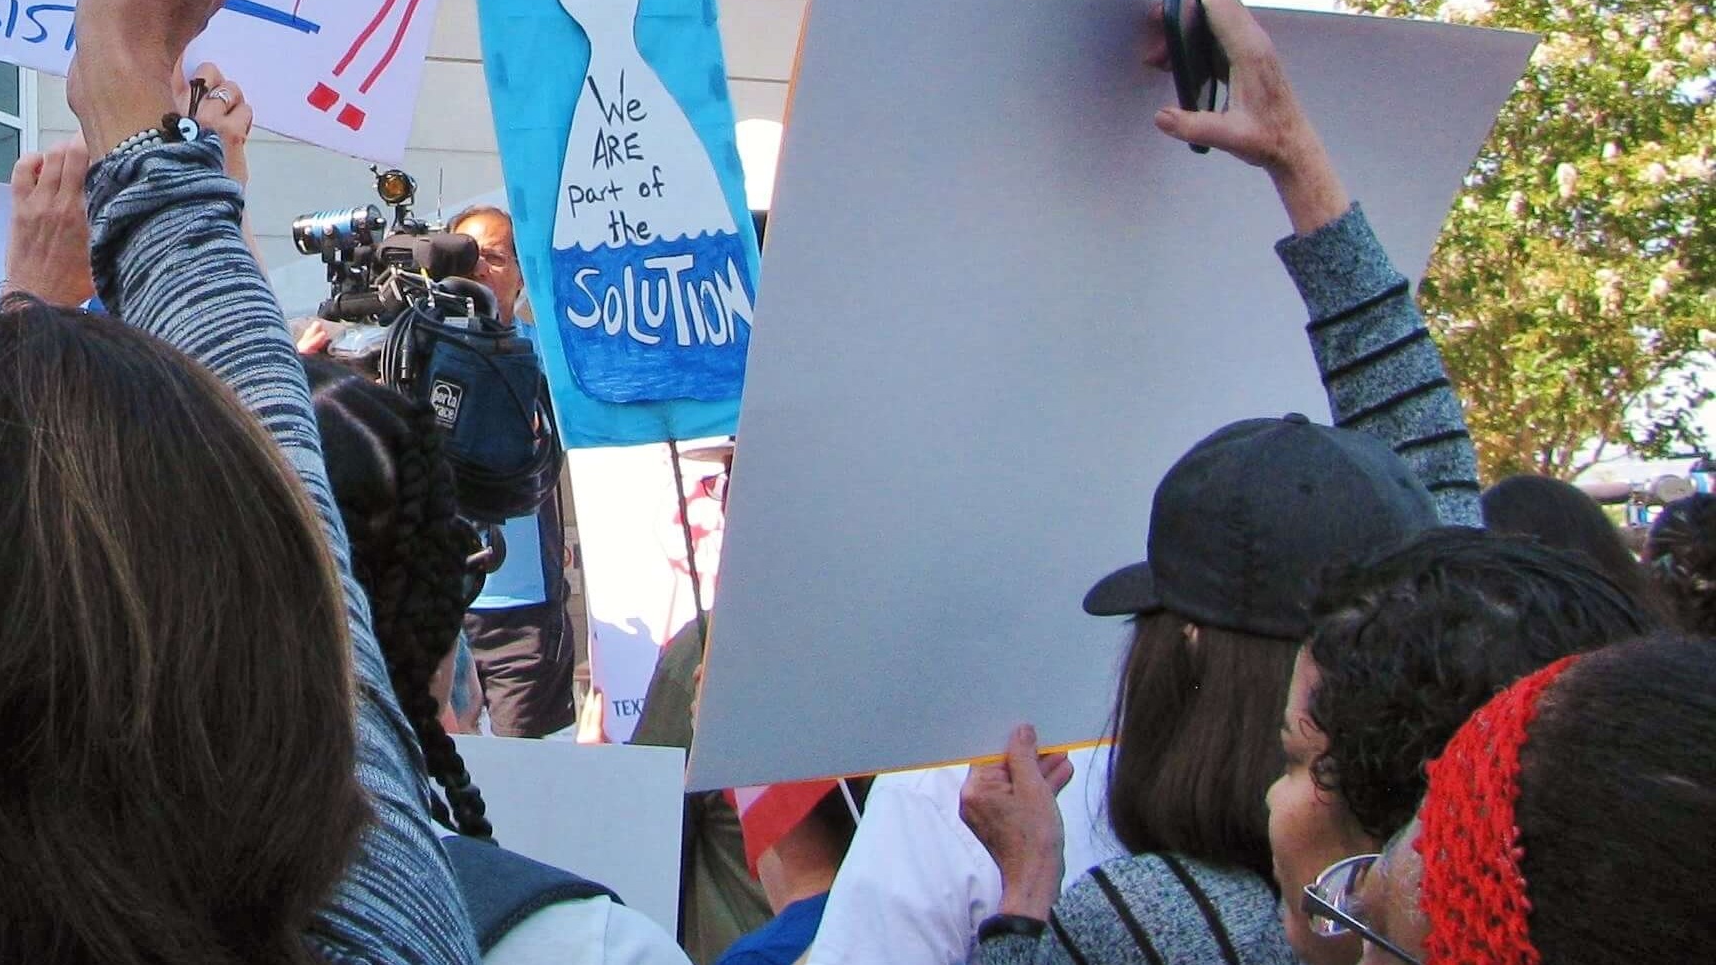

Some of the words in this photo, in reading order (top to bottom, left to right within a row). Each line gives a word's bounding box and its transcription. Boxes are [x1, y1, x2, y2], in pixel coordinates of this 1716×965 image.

[587, 69, 648, 125] We
[591, 131, 645, 172] ARE
[567, 182, 624, 218] part
[638, 165, 665, 199] of
[607, 209, 651, 244] the
